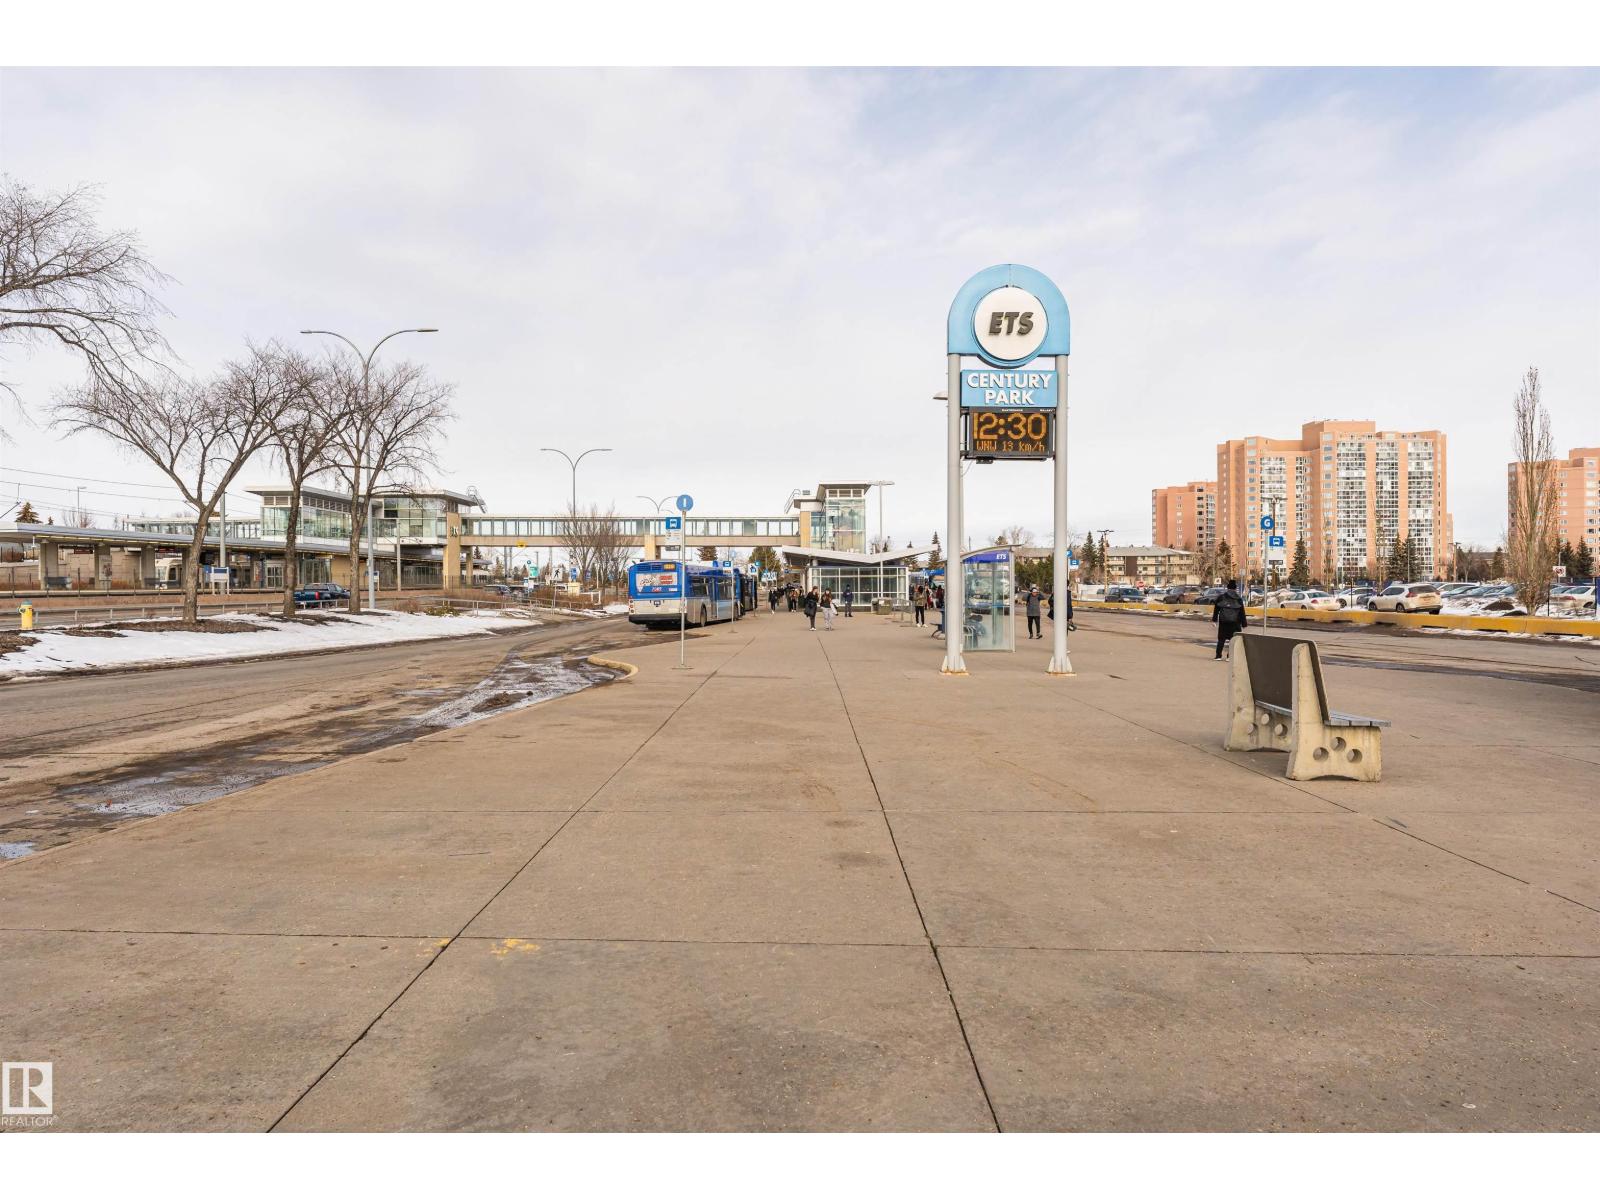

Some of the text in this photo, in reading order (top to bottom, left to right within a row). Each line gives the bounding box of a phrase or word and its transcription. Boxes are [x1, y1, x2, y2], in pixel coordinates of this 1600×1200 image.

[989, 311, 1034, 336] ETS
[968, 373, 1052, 388] CENTURY
[985, 390, 1034, 405] PARK
[973, 412, 1047, 440] 12:30
[976, 440, 1045, 452] WNW 13 km/h
[1264, 519, 1271, 527] G
